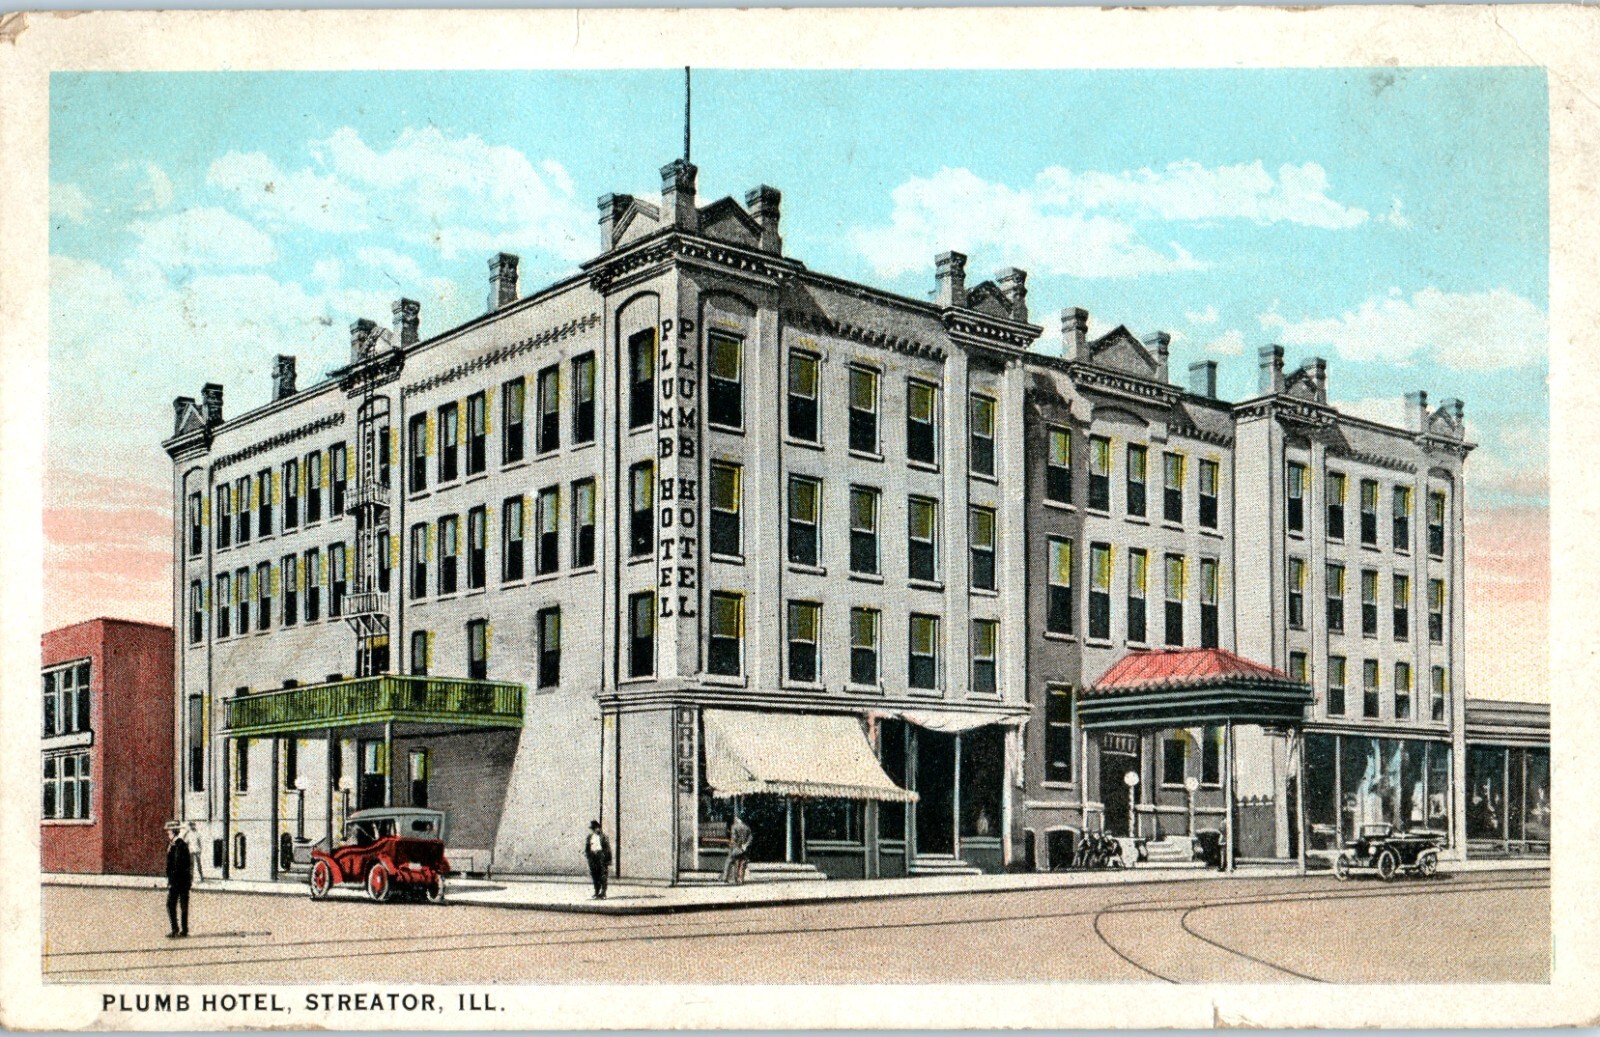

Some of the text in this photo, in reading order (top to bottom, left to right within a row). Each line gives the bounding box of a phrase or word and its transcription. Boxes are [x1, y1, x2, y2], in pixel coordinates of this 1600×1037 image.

[660, 318, 675, 618] PLUMB HOTEL
[677, 318, 696, 618] PLUMB HOTEL
